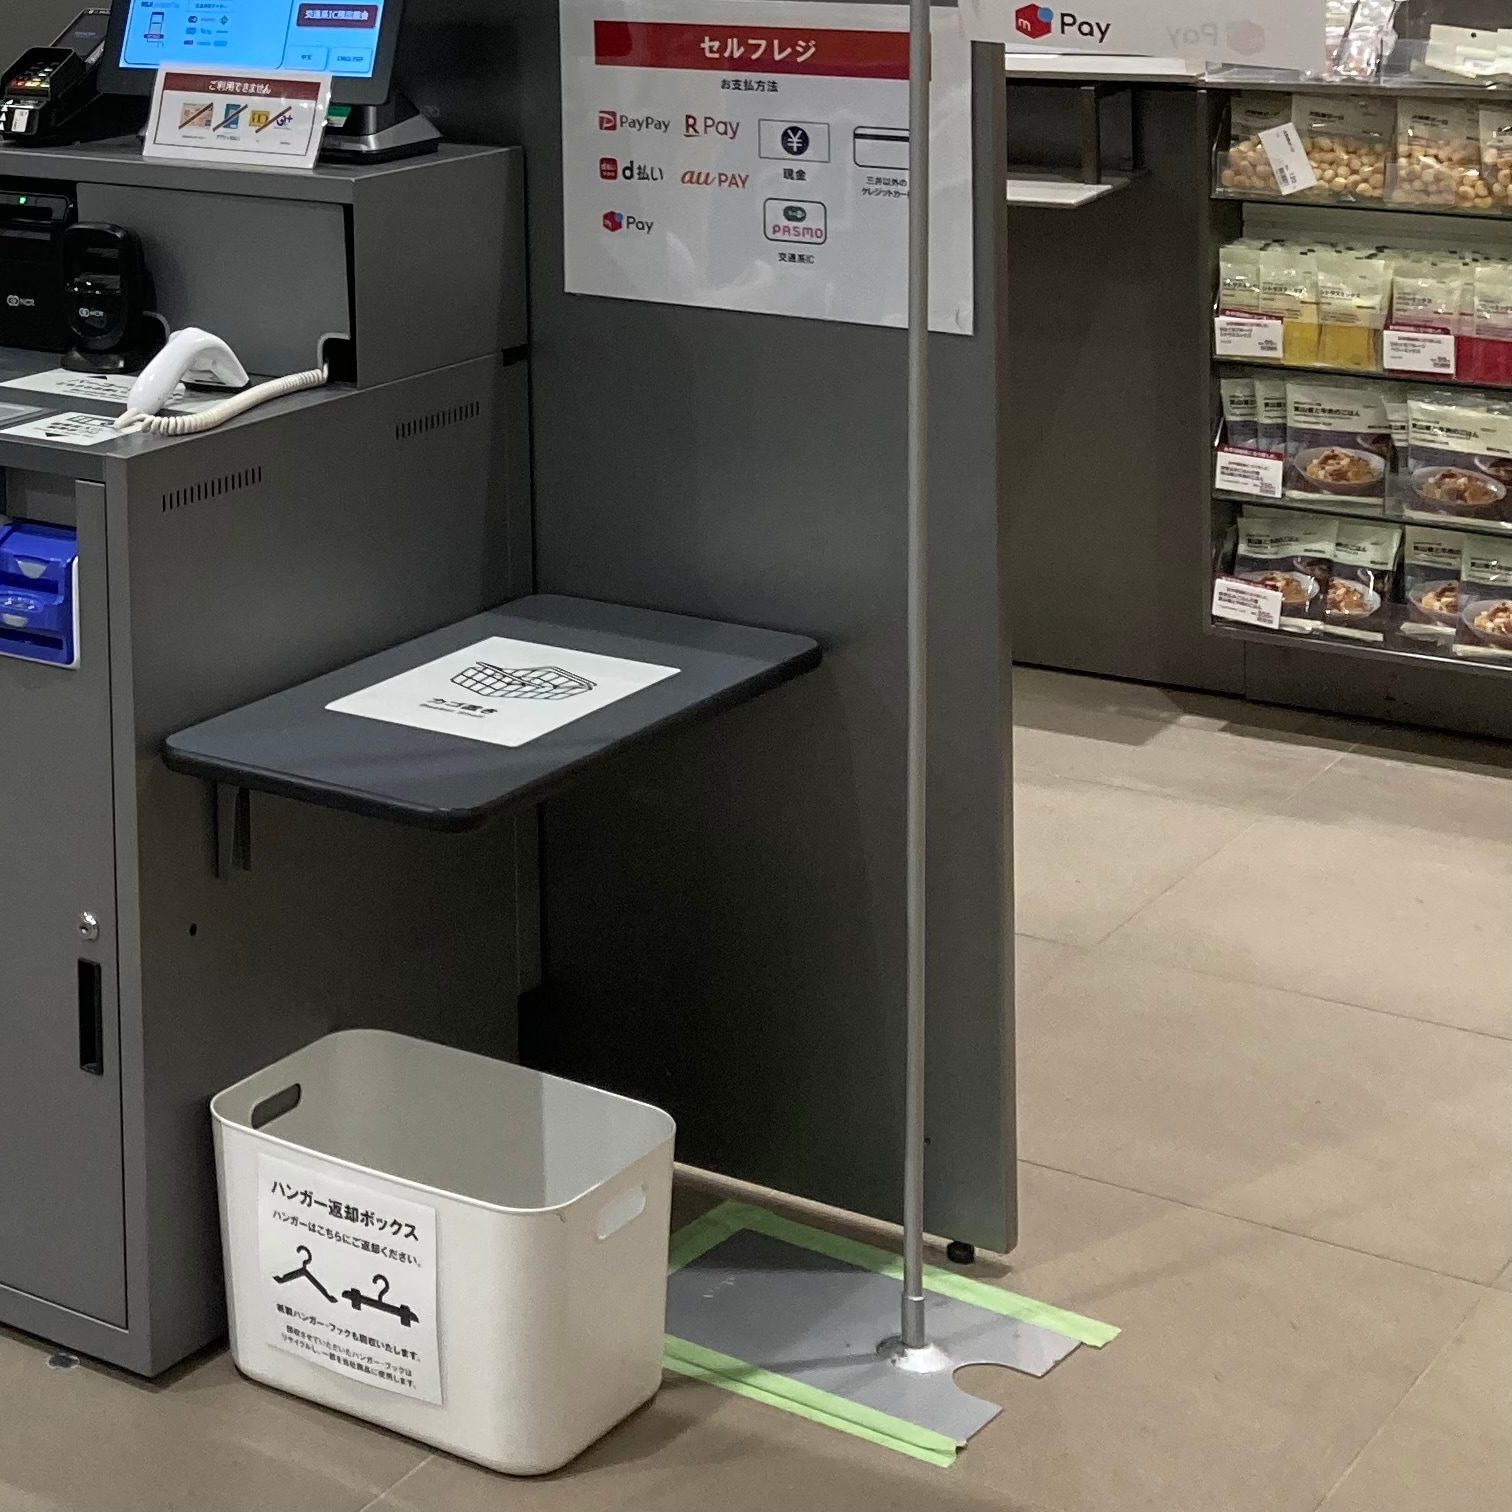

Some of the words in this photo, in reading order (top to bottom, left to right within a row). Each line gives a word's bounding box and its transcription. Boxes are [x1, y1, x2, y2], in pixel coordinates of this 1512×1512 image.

[1059, 12, 1112, 43] Pay
[699, 35, 817, 63] セルフレジ
[720, 78, 779, 93] お支払方法
[619, 114, 671, 132] PayPay
[703, 116, 740, 140] Pay
[622, 160, 665, 182] d払い
[680, 170, 716, 186] au
[717, 173, 750, 189] PAY
[783, 168, 807, 182] 現金
[861, 187, 910, 198] クレジットカー
[626, 216, 654, 235] Pay
[771, 224, 824, 240] PASMO
[271, 1180, 420, 1242] ハンガー返却ボックス
[272, 1210, 422, 1268] ハンガーはこちらにご返却ください。
